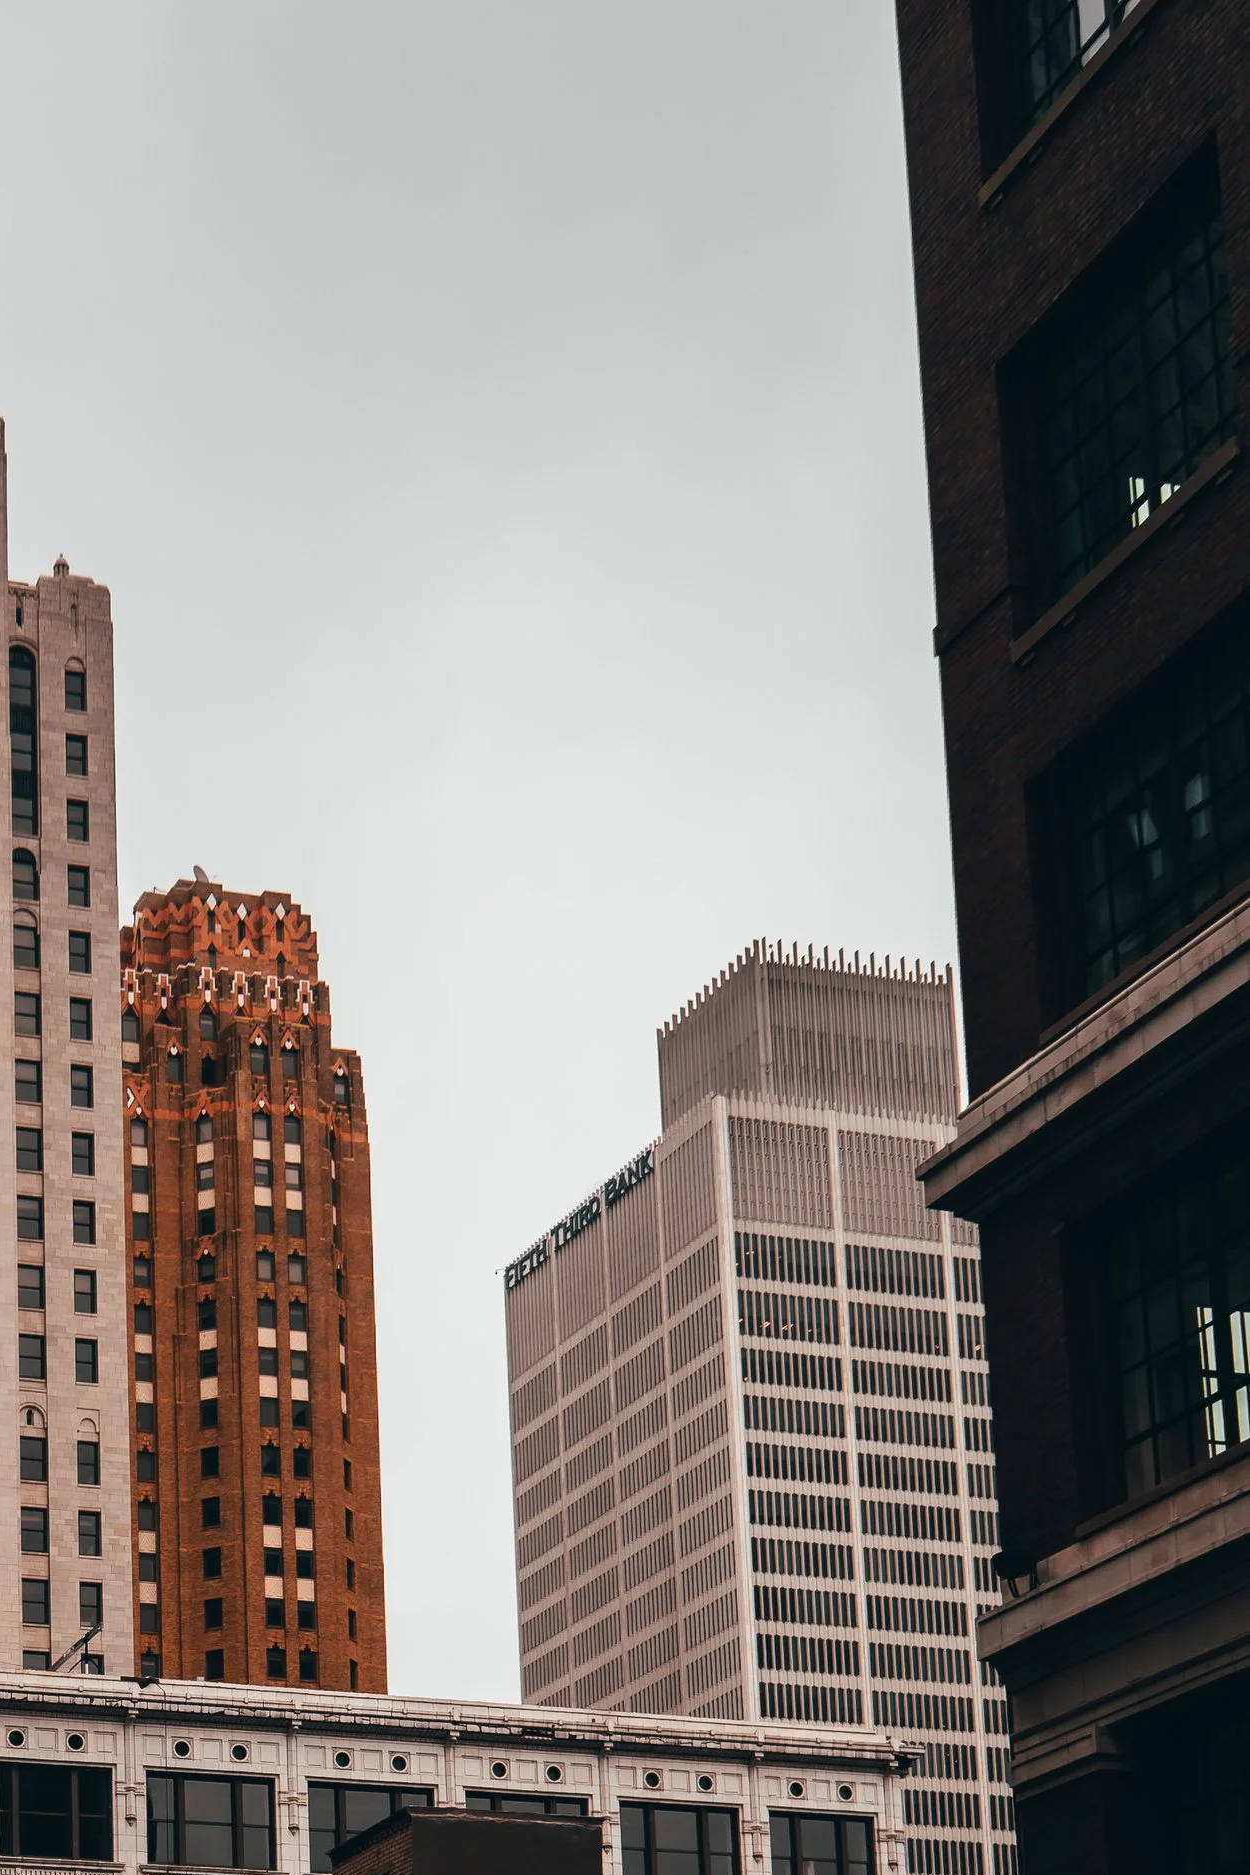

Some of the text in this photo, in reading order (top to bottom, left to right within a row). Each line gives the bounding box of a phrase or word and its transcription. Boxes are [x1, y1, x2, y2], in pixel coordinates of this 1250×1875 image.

[505, 1150, 654, 1290] FIFTH THIRD BANK
